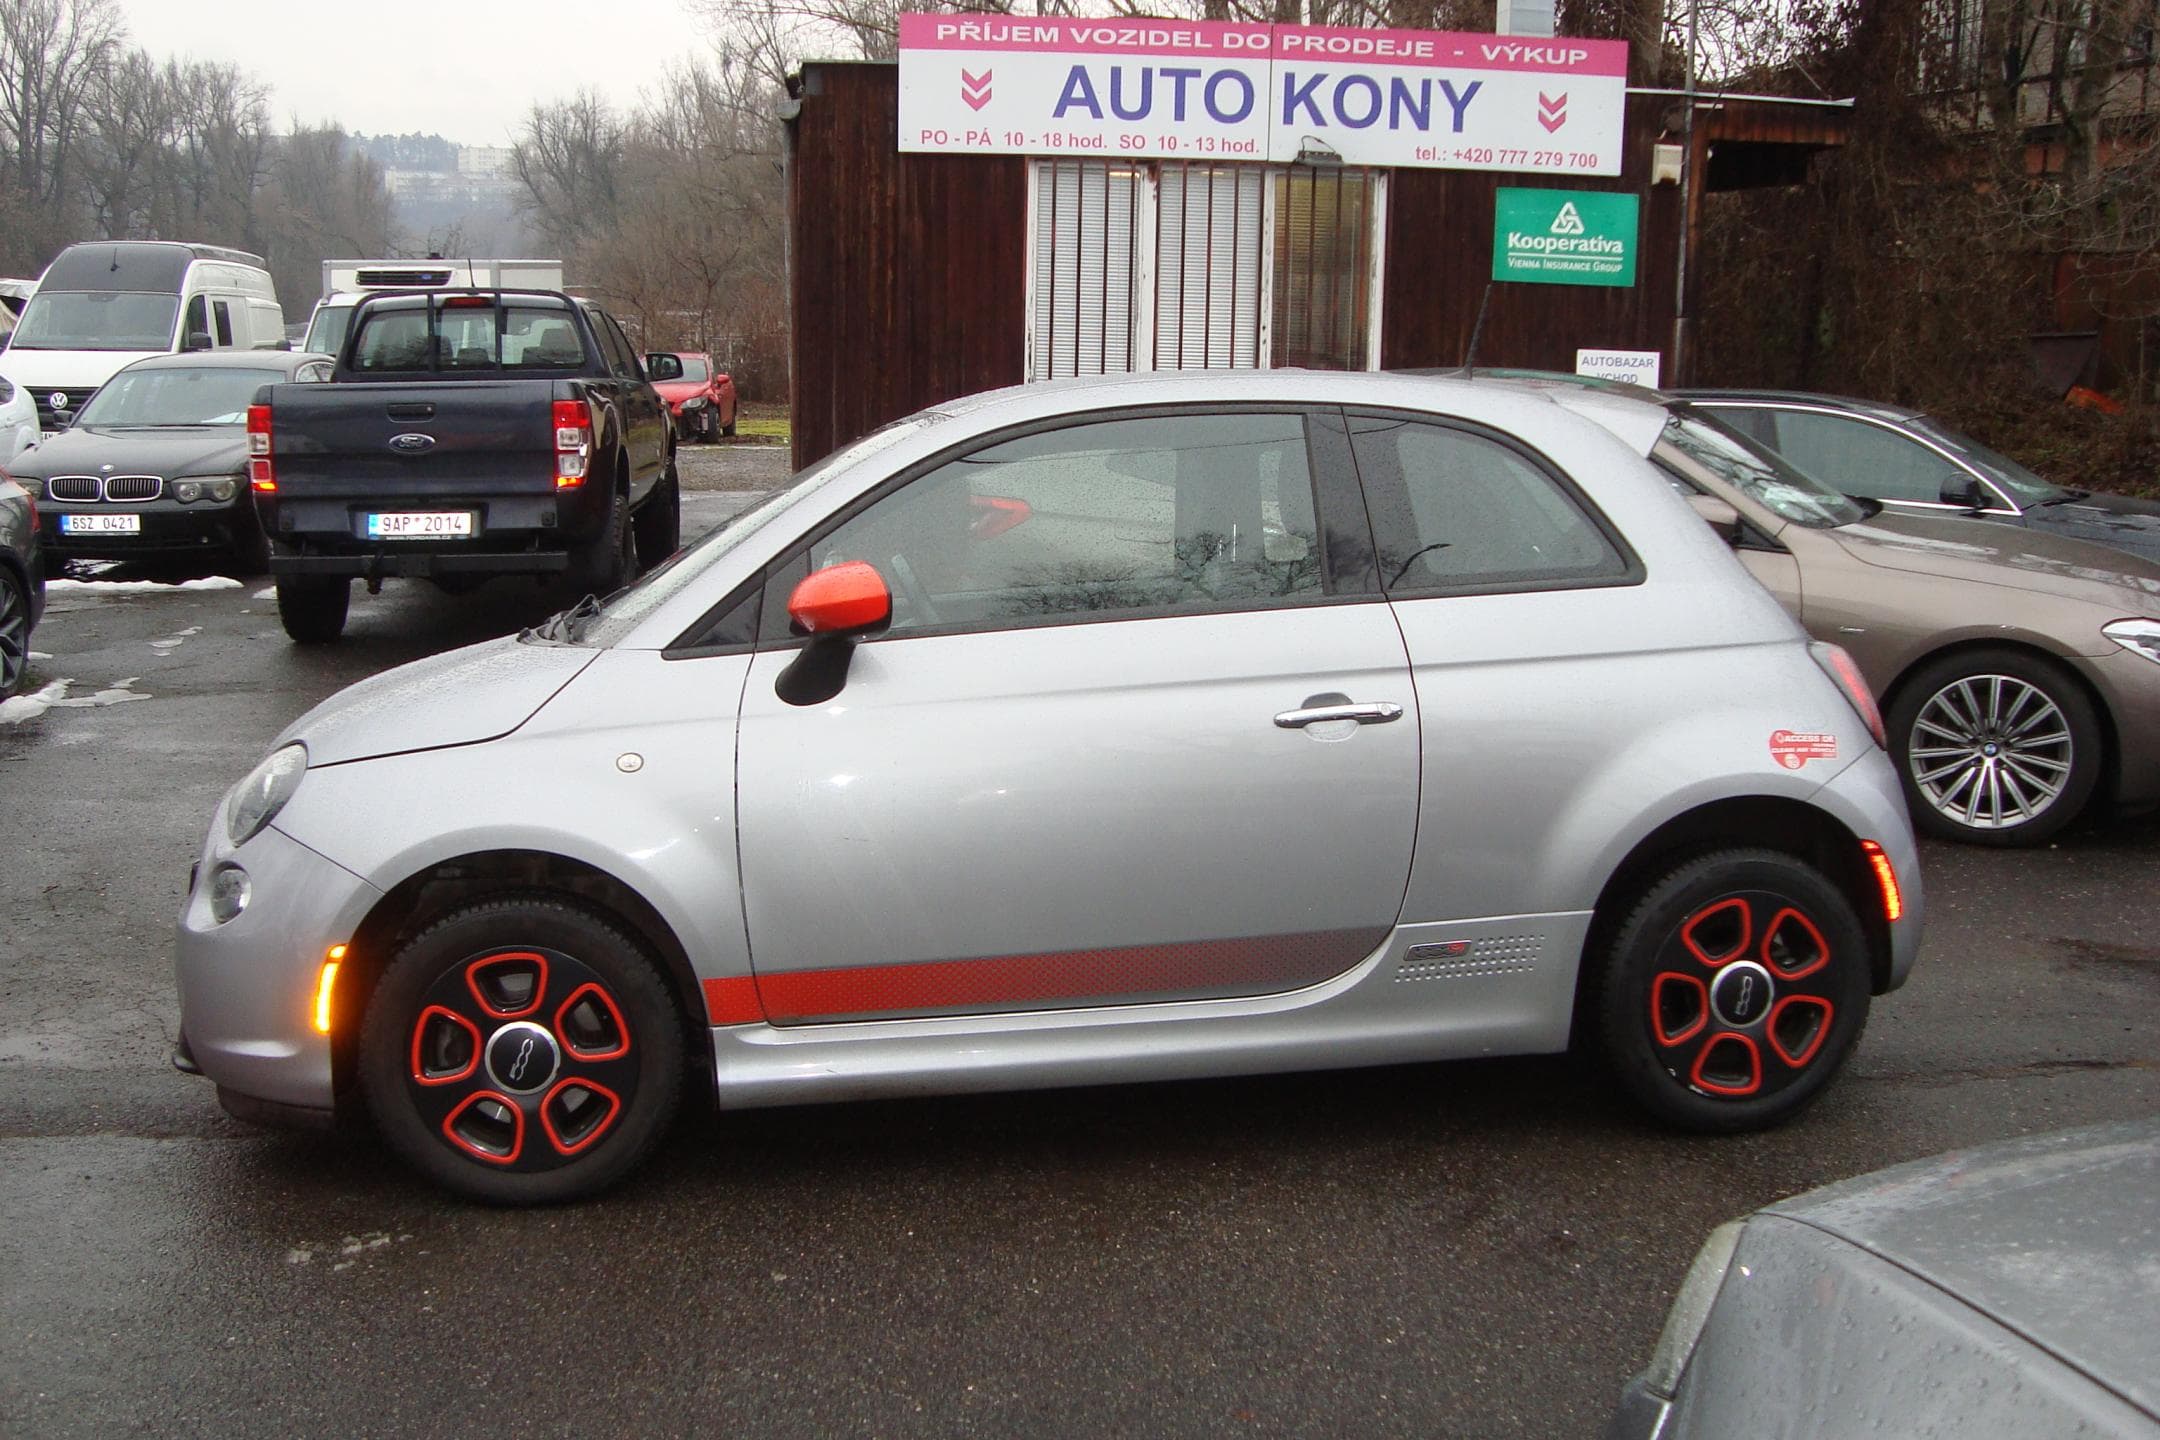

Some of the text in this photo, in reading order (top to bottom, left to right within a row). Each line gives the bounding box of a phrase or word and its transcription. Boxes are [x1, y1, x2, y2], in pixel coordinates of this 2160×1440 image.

[937, 21, 1060, 43] PŘÍJEM
[1070, 27, 1212, 48] VOZIDEL
[1222, 33, 1271, 50] DO
[1282, 35, 1434, 58] PRODEJE
[1481, 43, 1588, 65] VÝKUP
[1052, 64, 1484, 133] AUTO KONY
[921, 130, 948, 145] PO
[966, 127, 992, 146] PÁ
[1004, 132, 1024, 147] 10
[1042, 133, 1062, 147] 18
[1068, 133, 1108, 149] hod.
[1119, 134, 1146, 150] SO
[1158, 136, 1177, 151] 10
[1195, 137, 1215, 152] 13
[1221, 138, 1260, 153] hod.
[1415, 146, 1598, 168] tel.: +420 777 279 700
[1508, 231, 1624, 254] Kooperativa
[1581, 356, 1654, 368] AUTOBAZAR
[72, 517, 133, 529] 6SZ 0421
[383, 516, 461, 531] 9AP 2014
